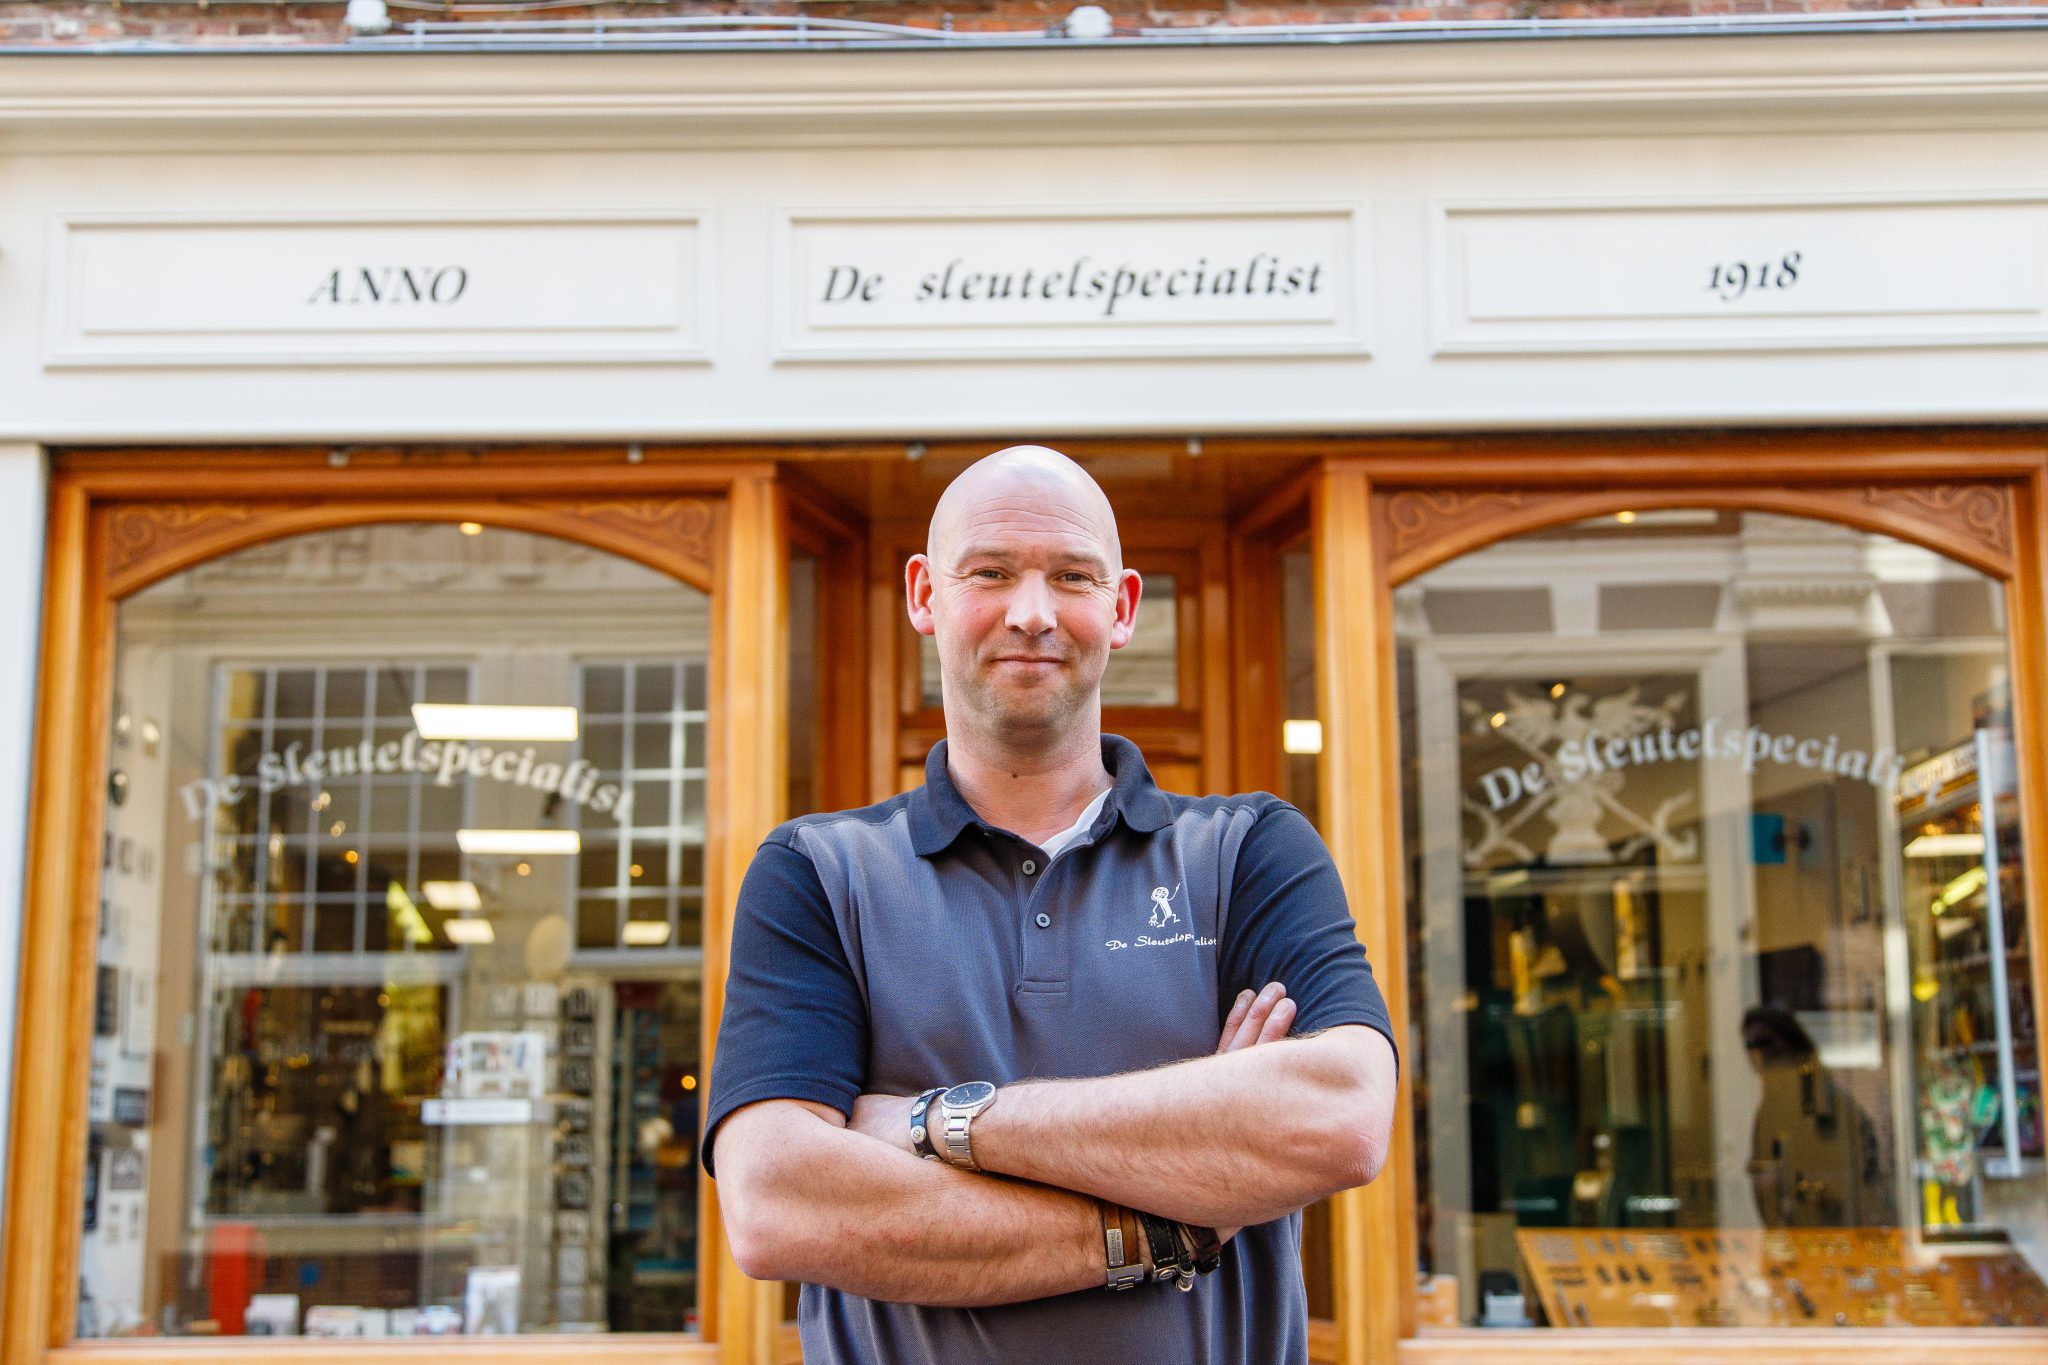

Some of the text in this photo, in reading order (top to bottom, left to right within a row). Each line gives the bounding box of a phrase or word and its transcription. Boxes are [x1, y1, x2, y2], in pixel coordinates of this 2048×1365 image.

[307, 264, 469, 306] ANNO
[819, 253, 1325, 317] De sleutelspecialist
[1705, 250, 1803, 301] 1918
[179, 771, 247, 823] De
[1478, 761, 1548, 813] De
[1105, 939, 1128, 951] De
